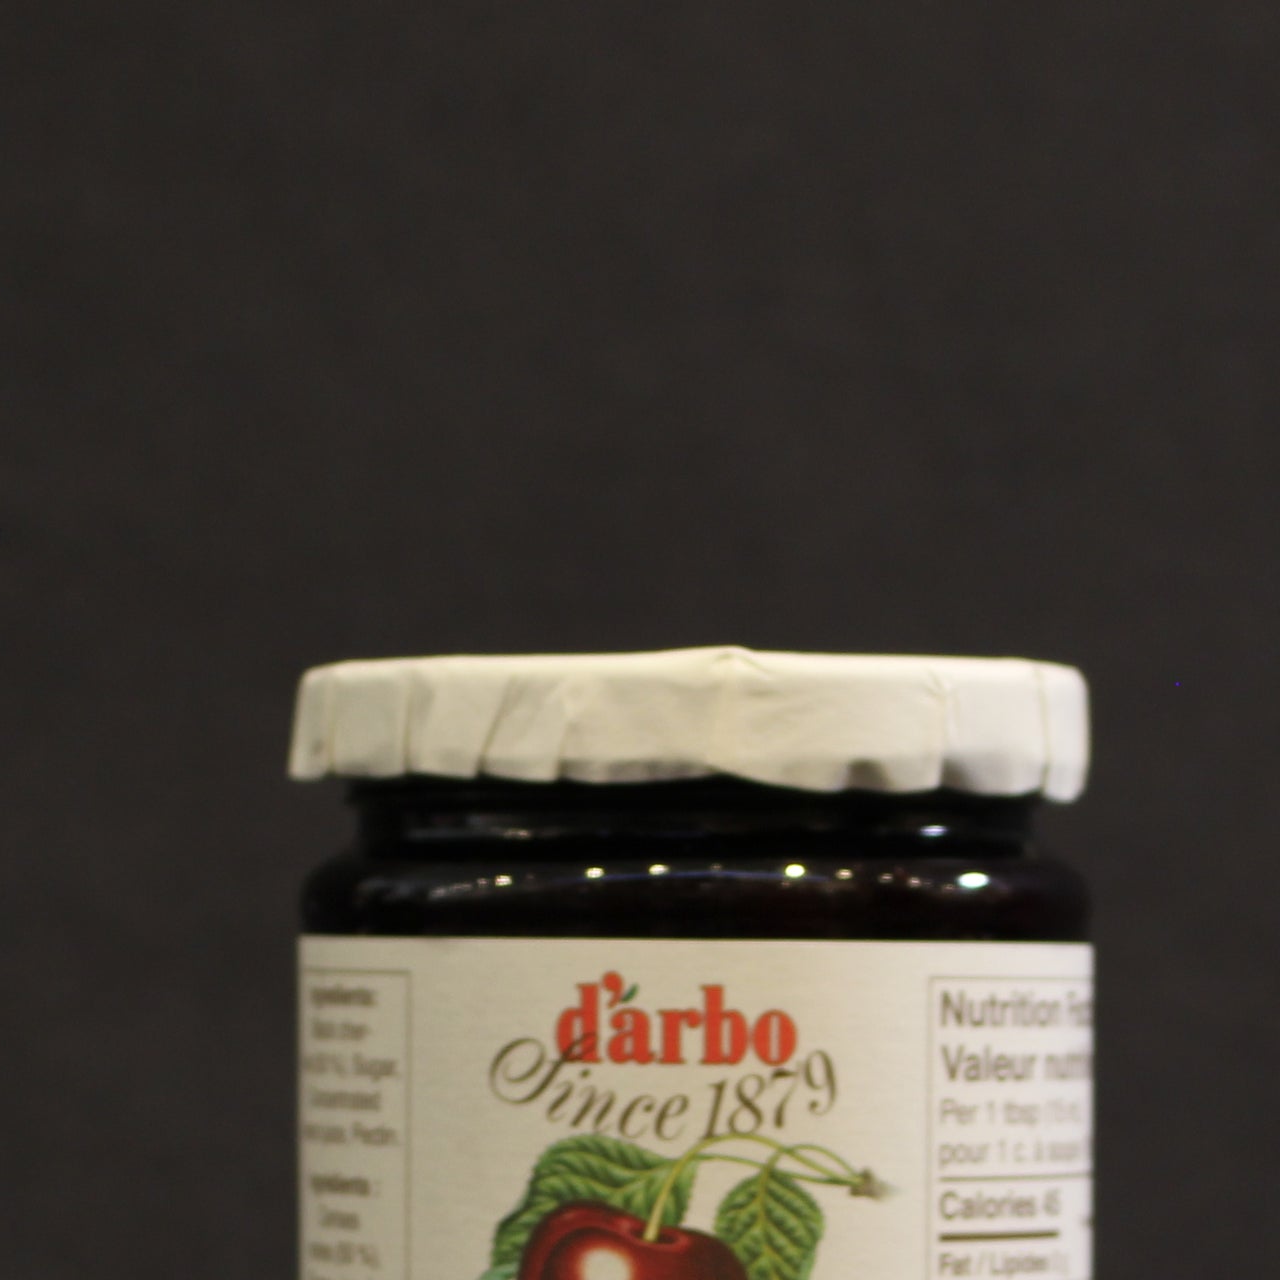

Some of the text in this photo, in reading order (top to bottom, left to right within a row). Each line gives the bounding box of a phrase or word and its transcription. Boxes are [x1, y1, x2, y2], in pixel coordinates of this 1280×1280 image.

[941, 990, 1059, 1028] Nutrition
[941, 1044, 1036, 1082] Valeur
[489, 1033, 838, 1140] Since 1879
[940, 1098, 978, 1125] Per
[938, 1143, 988, 1169] pour
[939, 1190, 1036, 1221] Calories
[939, 1253, 971, 1276] Fat
